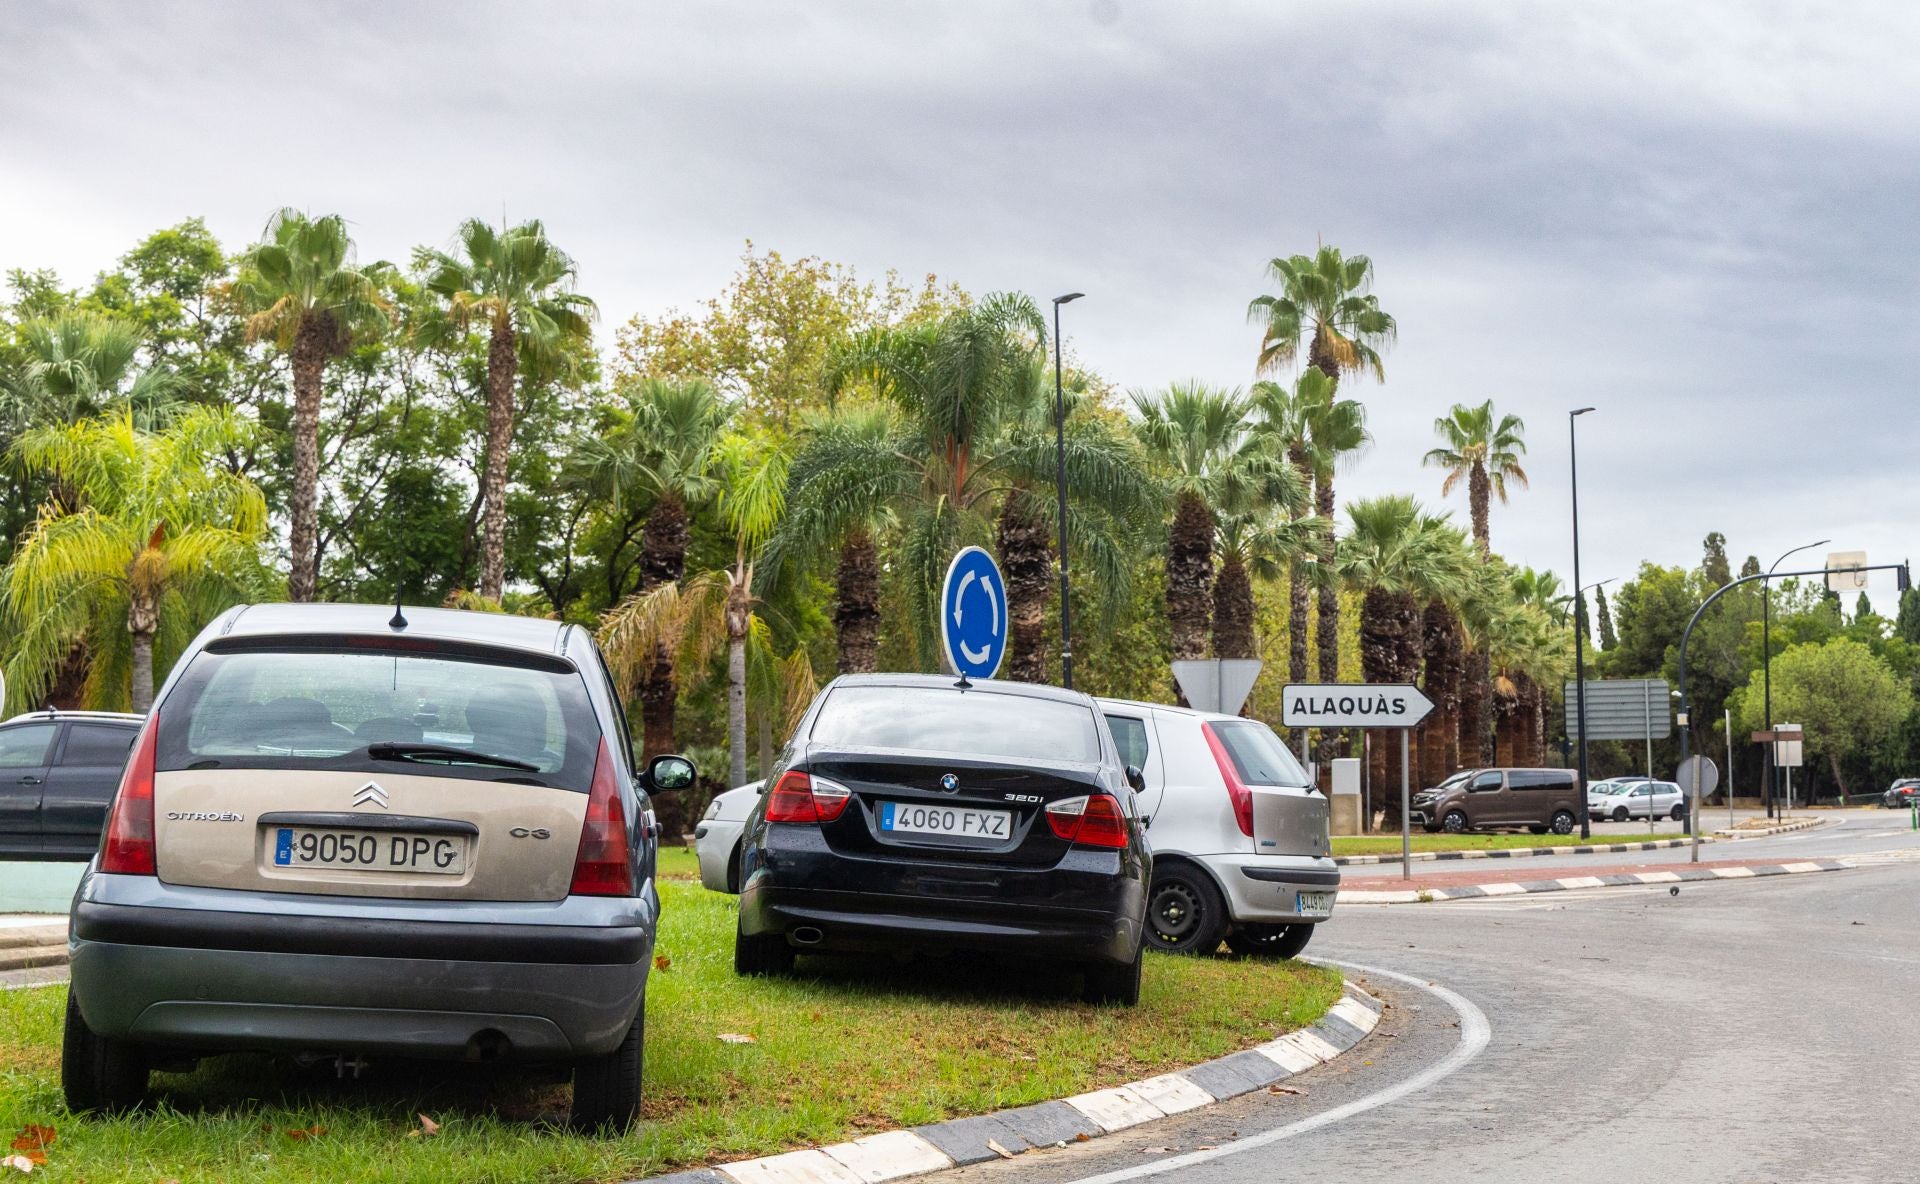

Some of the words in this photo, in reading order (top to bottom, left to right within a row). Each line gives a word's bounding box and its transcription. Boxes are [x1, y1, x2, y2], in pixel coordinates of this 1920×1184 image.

[1292, 694, 1406, 715] ALAQUÀS
[509, 827, 551, 839] C3
[898, 808, 955, 830] 4060
[962, 813, 1006, 835] FXZ
[279, 850, 288, 859] E
[299, 833, 377, 864] 9050
[390, 837, 453, 868] DPG
